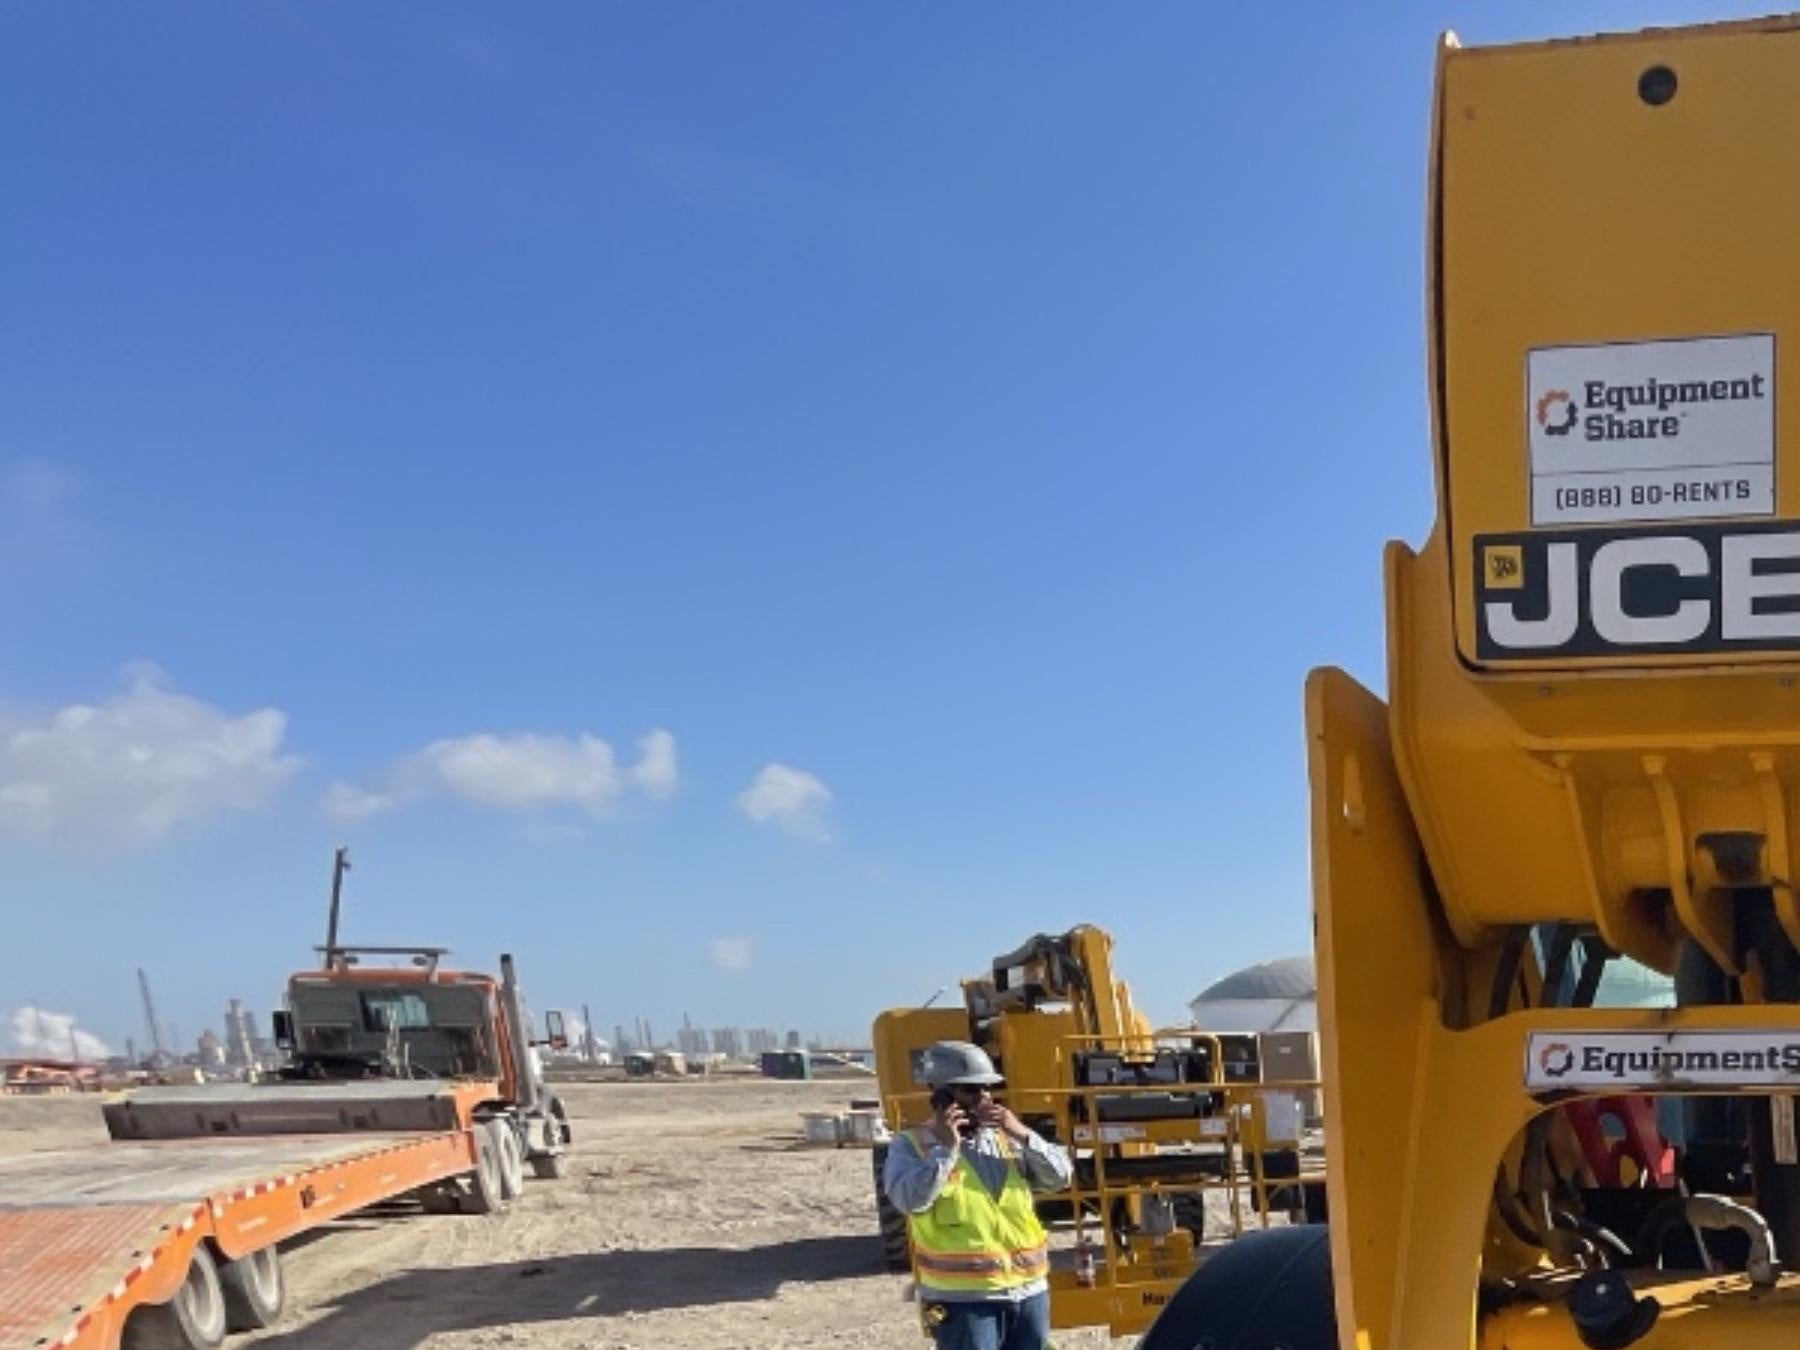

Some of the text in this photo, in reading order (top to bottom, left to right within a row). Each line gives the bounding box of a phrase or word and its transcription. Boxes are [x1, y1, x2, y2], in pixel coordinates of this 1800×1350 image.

[1584, 373, 1764, 413] Equipment
[1585, 412, 1680, 442] Share
[1556, 486, 1621, 510] (888)
